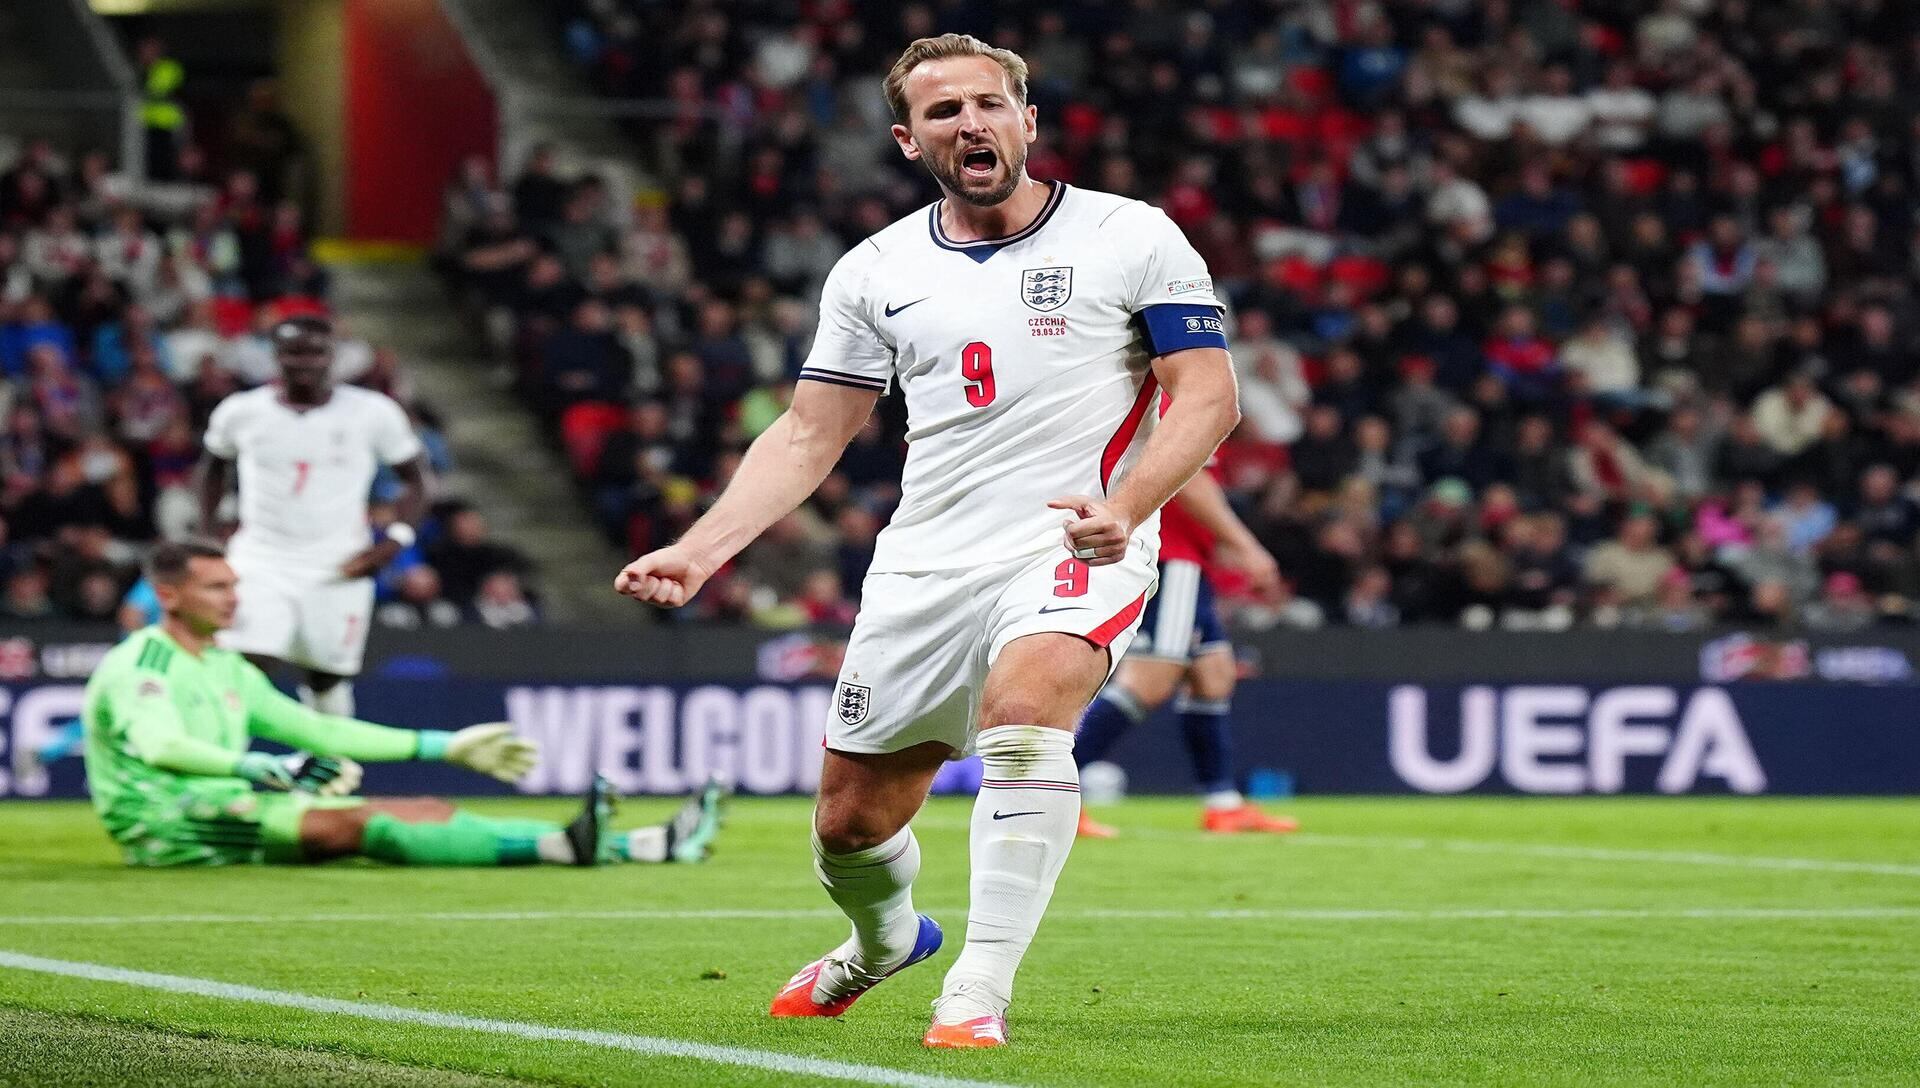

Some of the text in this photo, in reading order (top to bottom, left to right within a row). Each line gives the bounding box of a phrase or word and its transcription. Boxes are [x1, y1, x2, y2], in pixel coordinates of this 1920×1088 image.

[1028, 318, 1066, 326] CZECHIA
[1031, 327, 1065, 336] 29.09.26
[1203, 319, 1223, 331] RES
[961, 341, 996, 407] 9
[293, 460, 312, 496] 7
[1053, 557, 1089, 598] 9
[1388, 685, 1768, 794] UEFA
